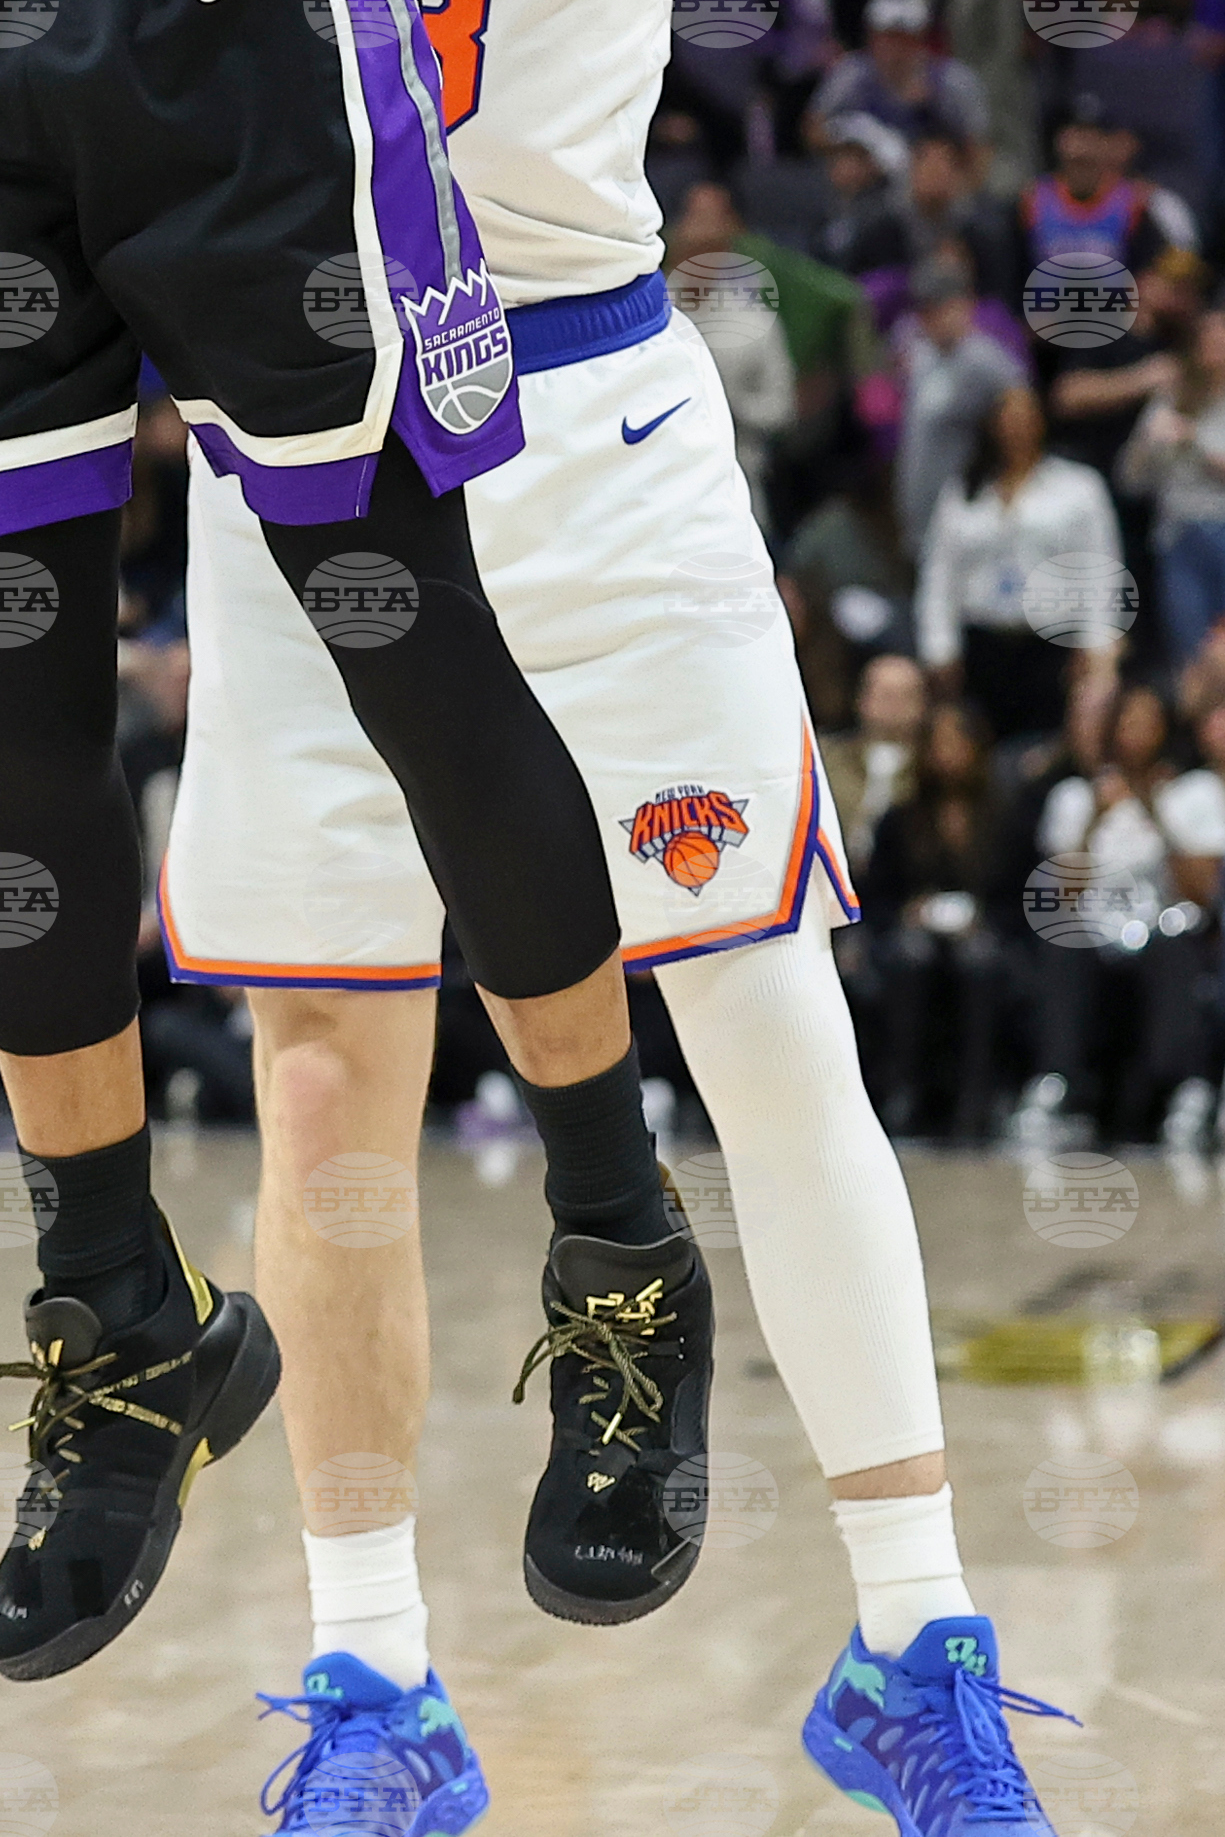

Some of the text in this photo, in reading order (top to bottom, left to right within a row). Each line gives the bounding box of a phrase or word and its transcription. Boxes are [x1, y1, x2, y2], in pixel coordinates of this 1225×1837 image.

[421, 325, 509, 387] KINGS
[424, 307, 500, 351] SACRAMENTO
[629, 790, 750, 856] KNICKS
